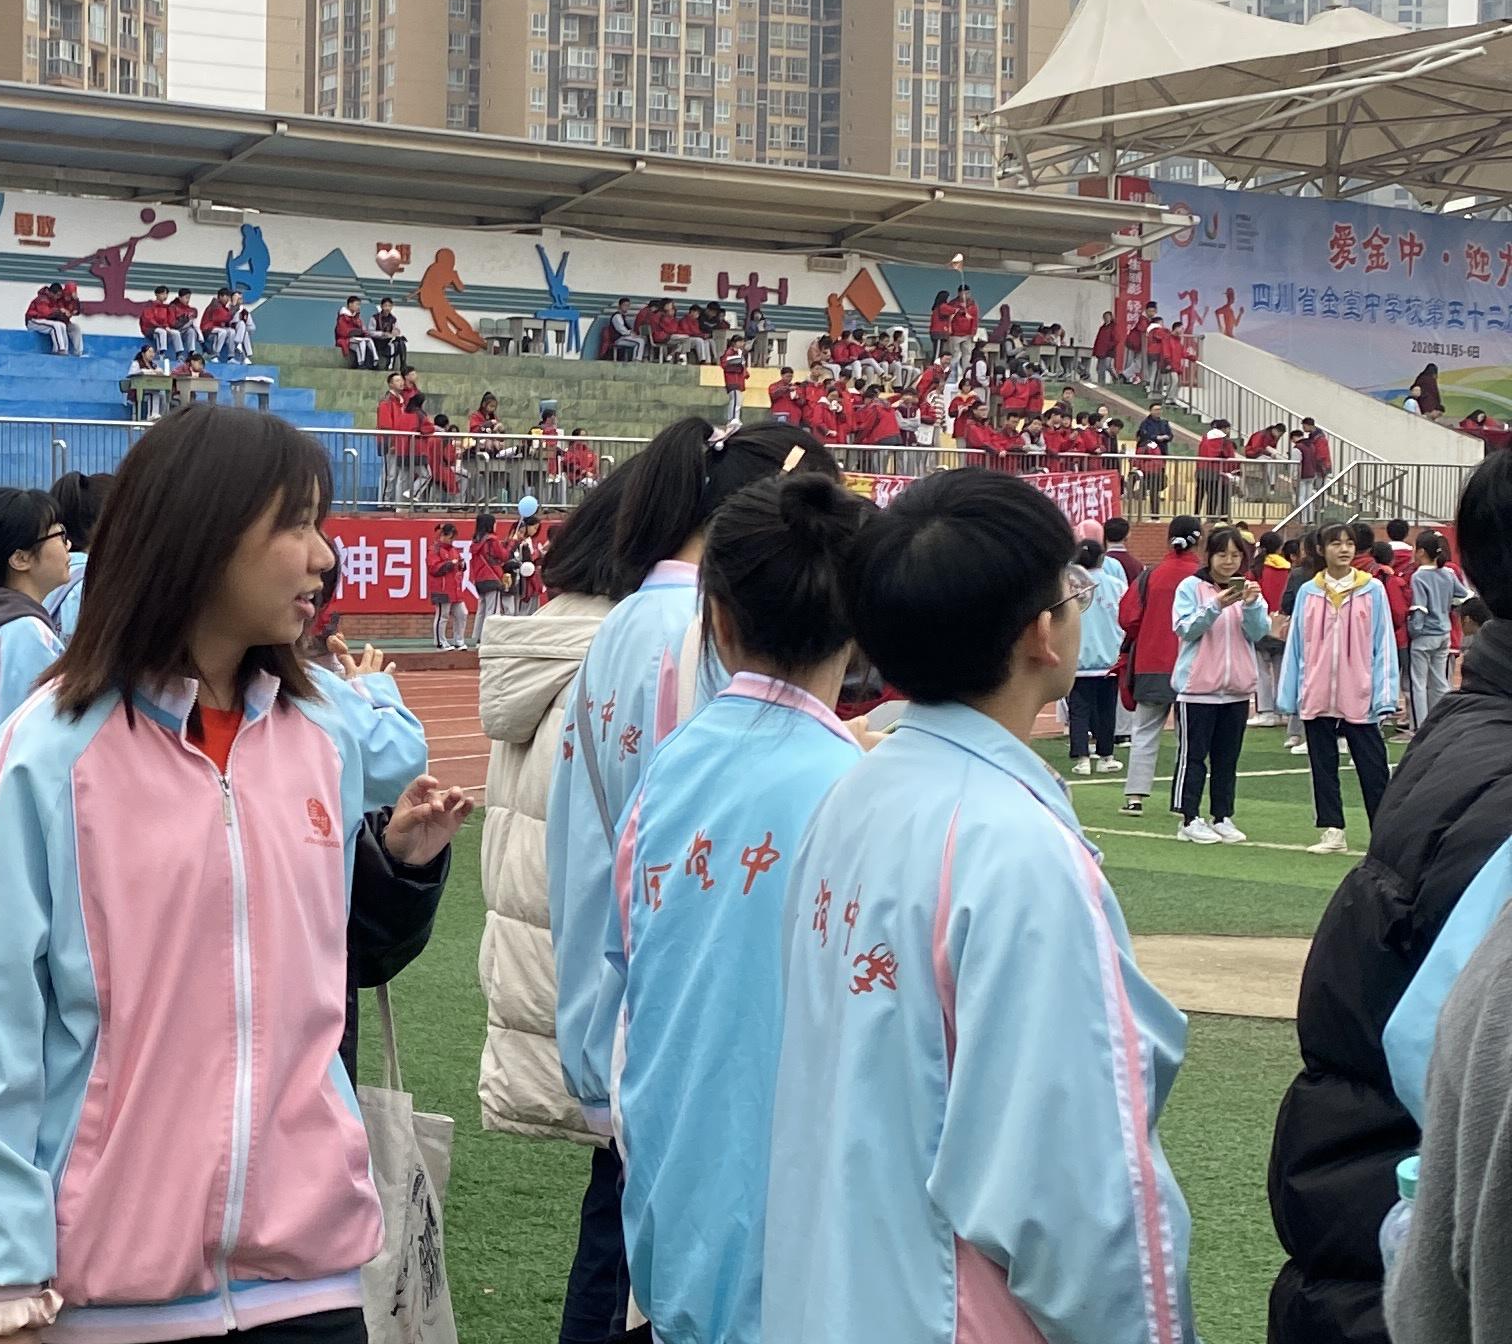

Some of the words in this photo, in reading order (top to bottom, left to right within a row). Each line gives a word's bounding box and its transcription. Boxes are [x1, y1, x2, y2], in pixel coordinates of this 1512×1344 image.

[1251, 282, 1512, 334] 四川省金堂中学校第五十二
